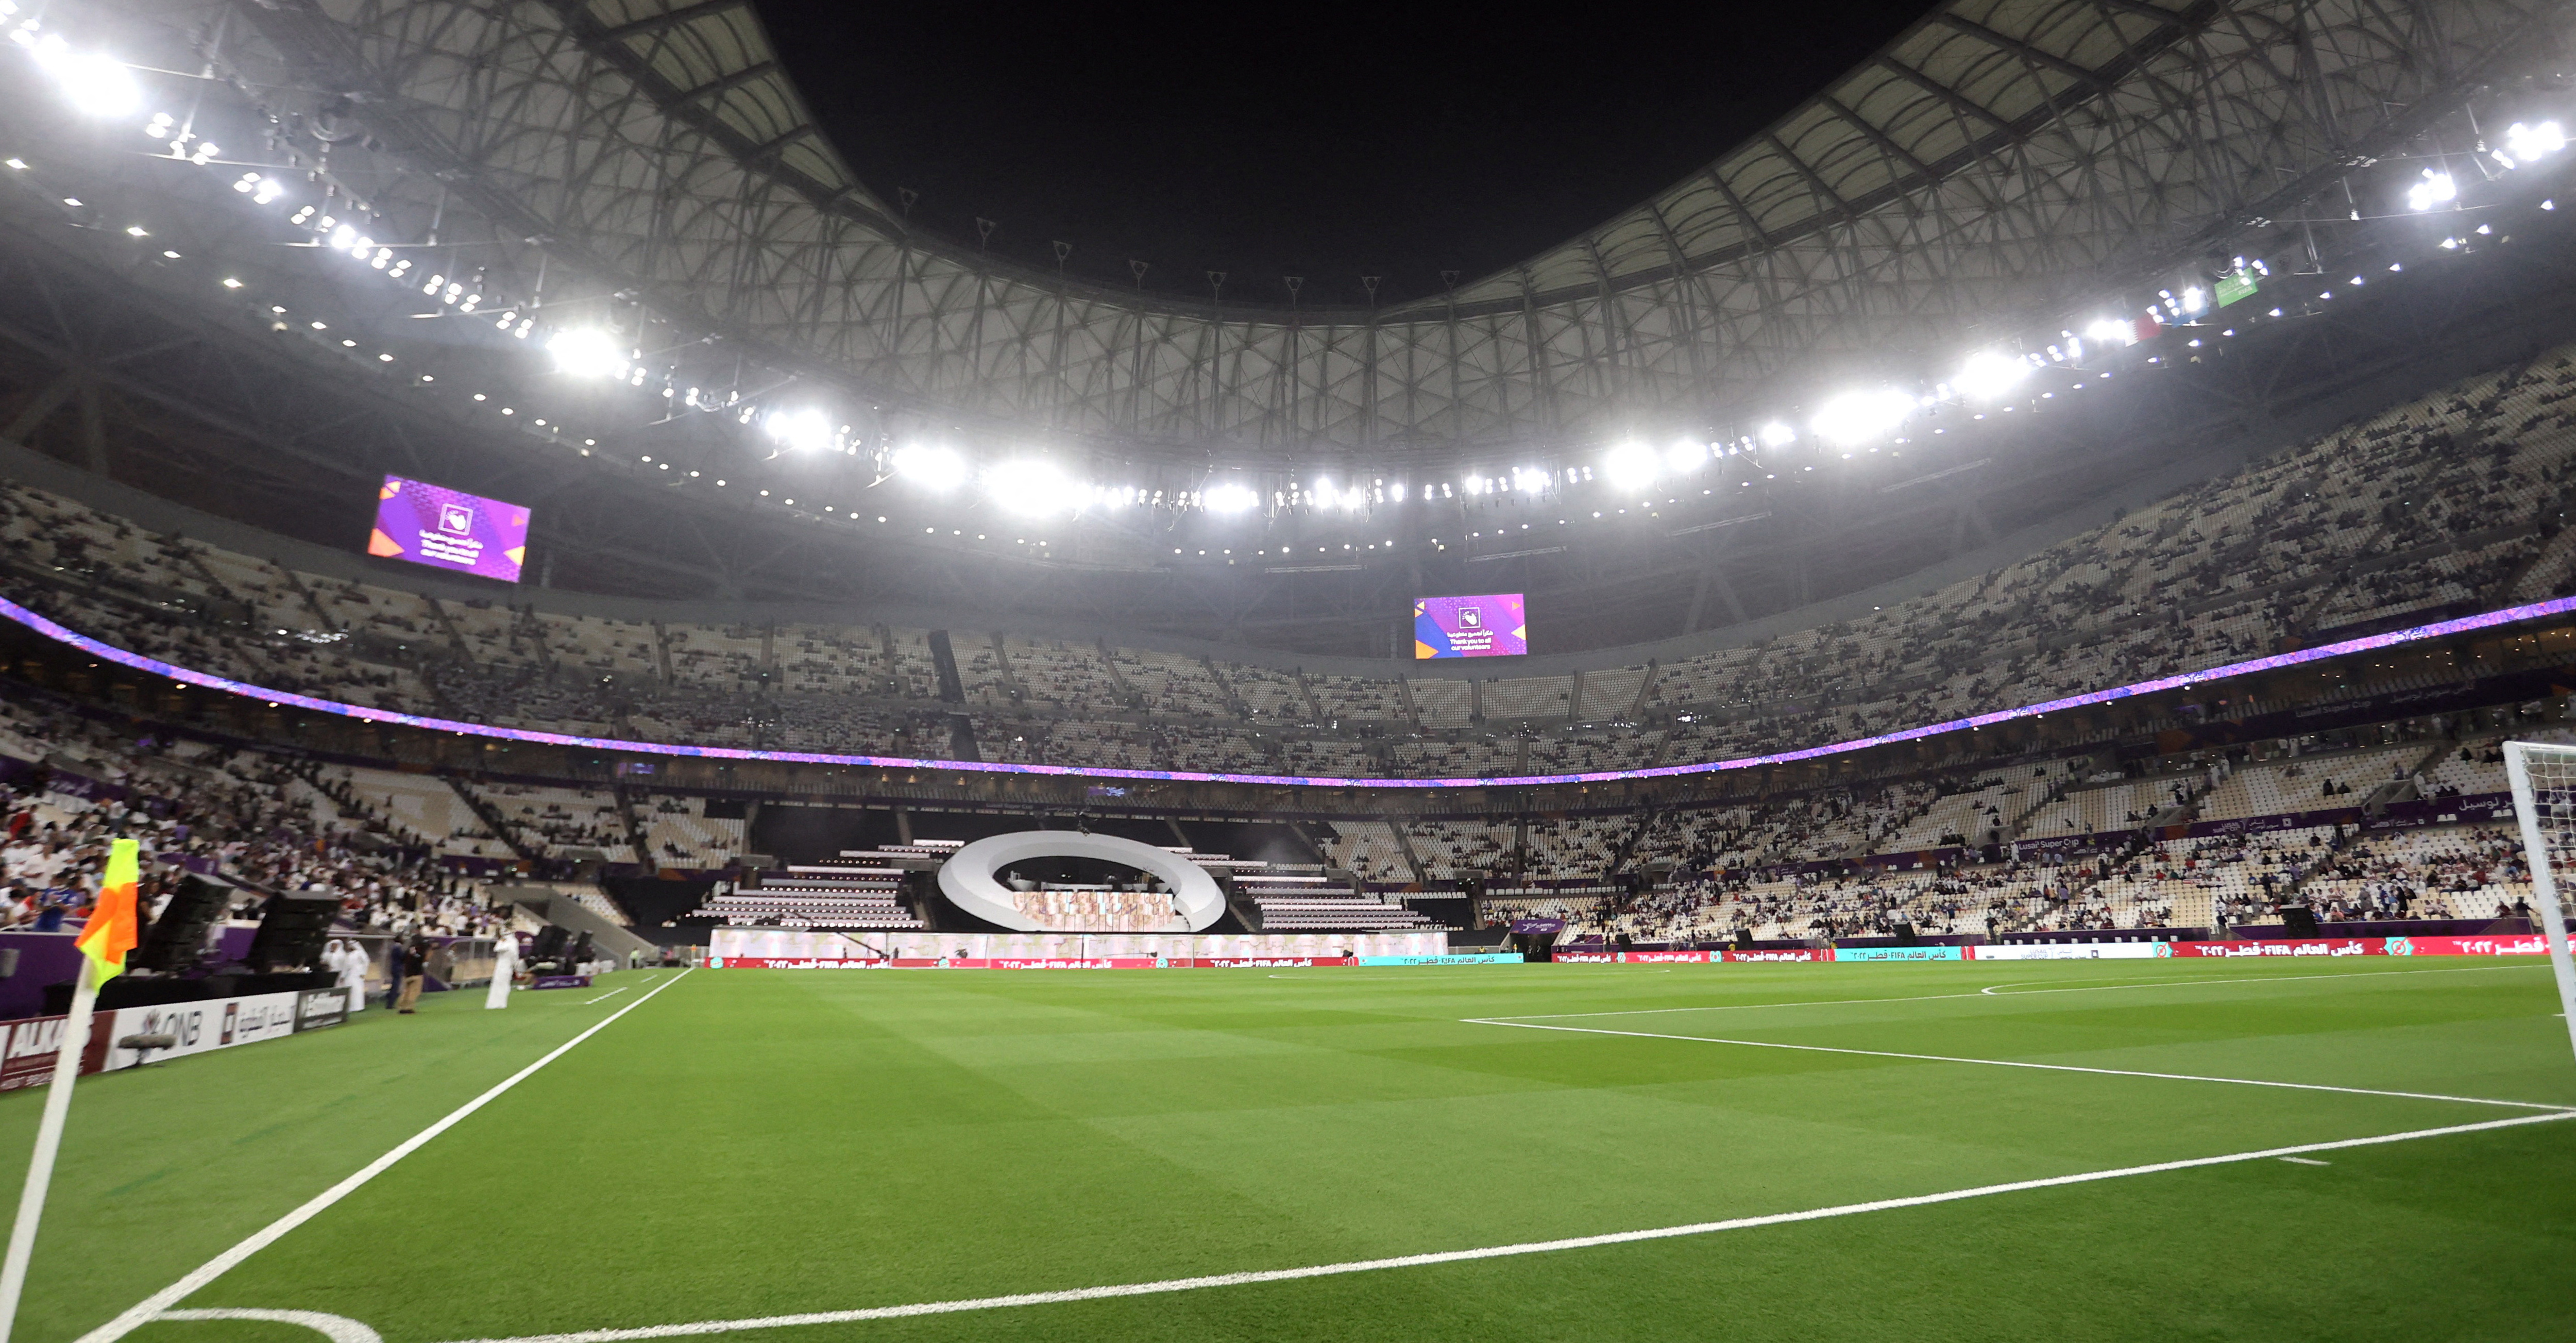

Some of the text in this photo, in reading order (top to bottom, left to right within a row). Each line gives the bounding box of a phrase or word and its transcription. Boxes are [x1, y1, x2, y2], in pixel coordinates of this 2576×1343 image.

[2040, 840, 2062, 850] Super
[2225, 942, 2261, 958] قطر
[2264, 945, 2292, 955] FIFA
[2293, 944, 2328, 956] العالم
[2331, 941, 2364, 956] كأس
[2495, 937, 2544, 957] قطر
[1478, 955, 1495, 964] كأس
[1747, 951, 1764, 962] قطر
[1766, 953, 1778, 961] FIFA
[1779, 953, 1795, 962] العالم
[1796, 951, 1811, 962] كأس
[1868, 950, 1888, 961] قطر
[1908, 951, 1926, 961] العالم
[1928, 949, 1946, 961] كأس
[1230, 958, 1253, 968] قطر
[1256, 959, 1272, 967] FIFA
[1273, 959, 1293, 967] العالم
[1294, 958, 1312, 967] كأس
[1418, 956, 1438, 965] قطر
[1458, 956, 1476, 965] العالم
[7, 1017, 94, 1060] ALKA
